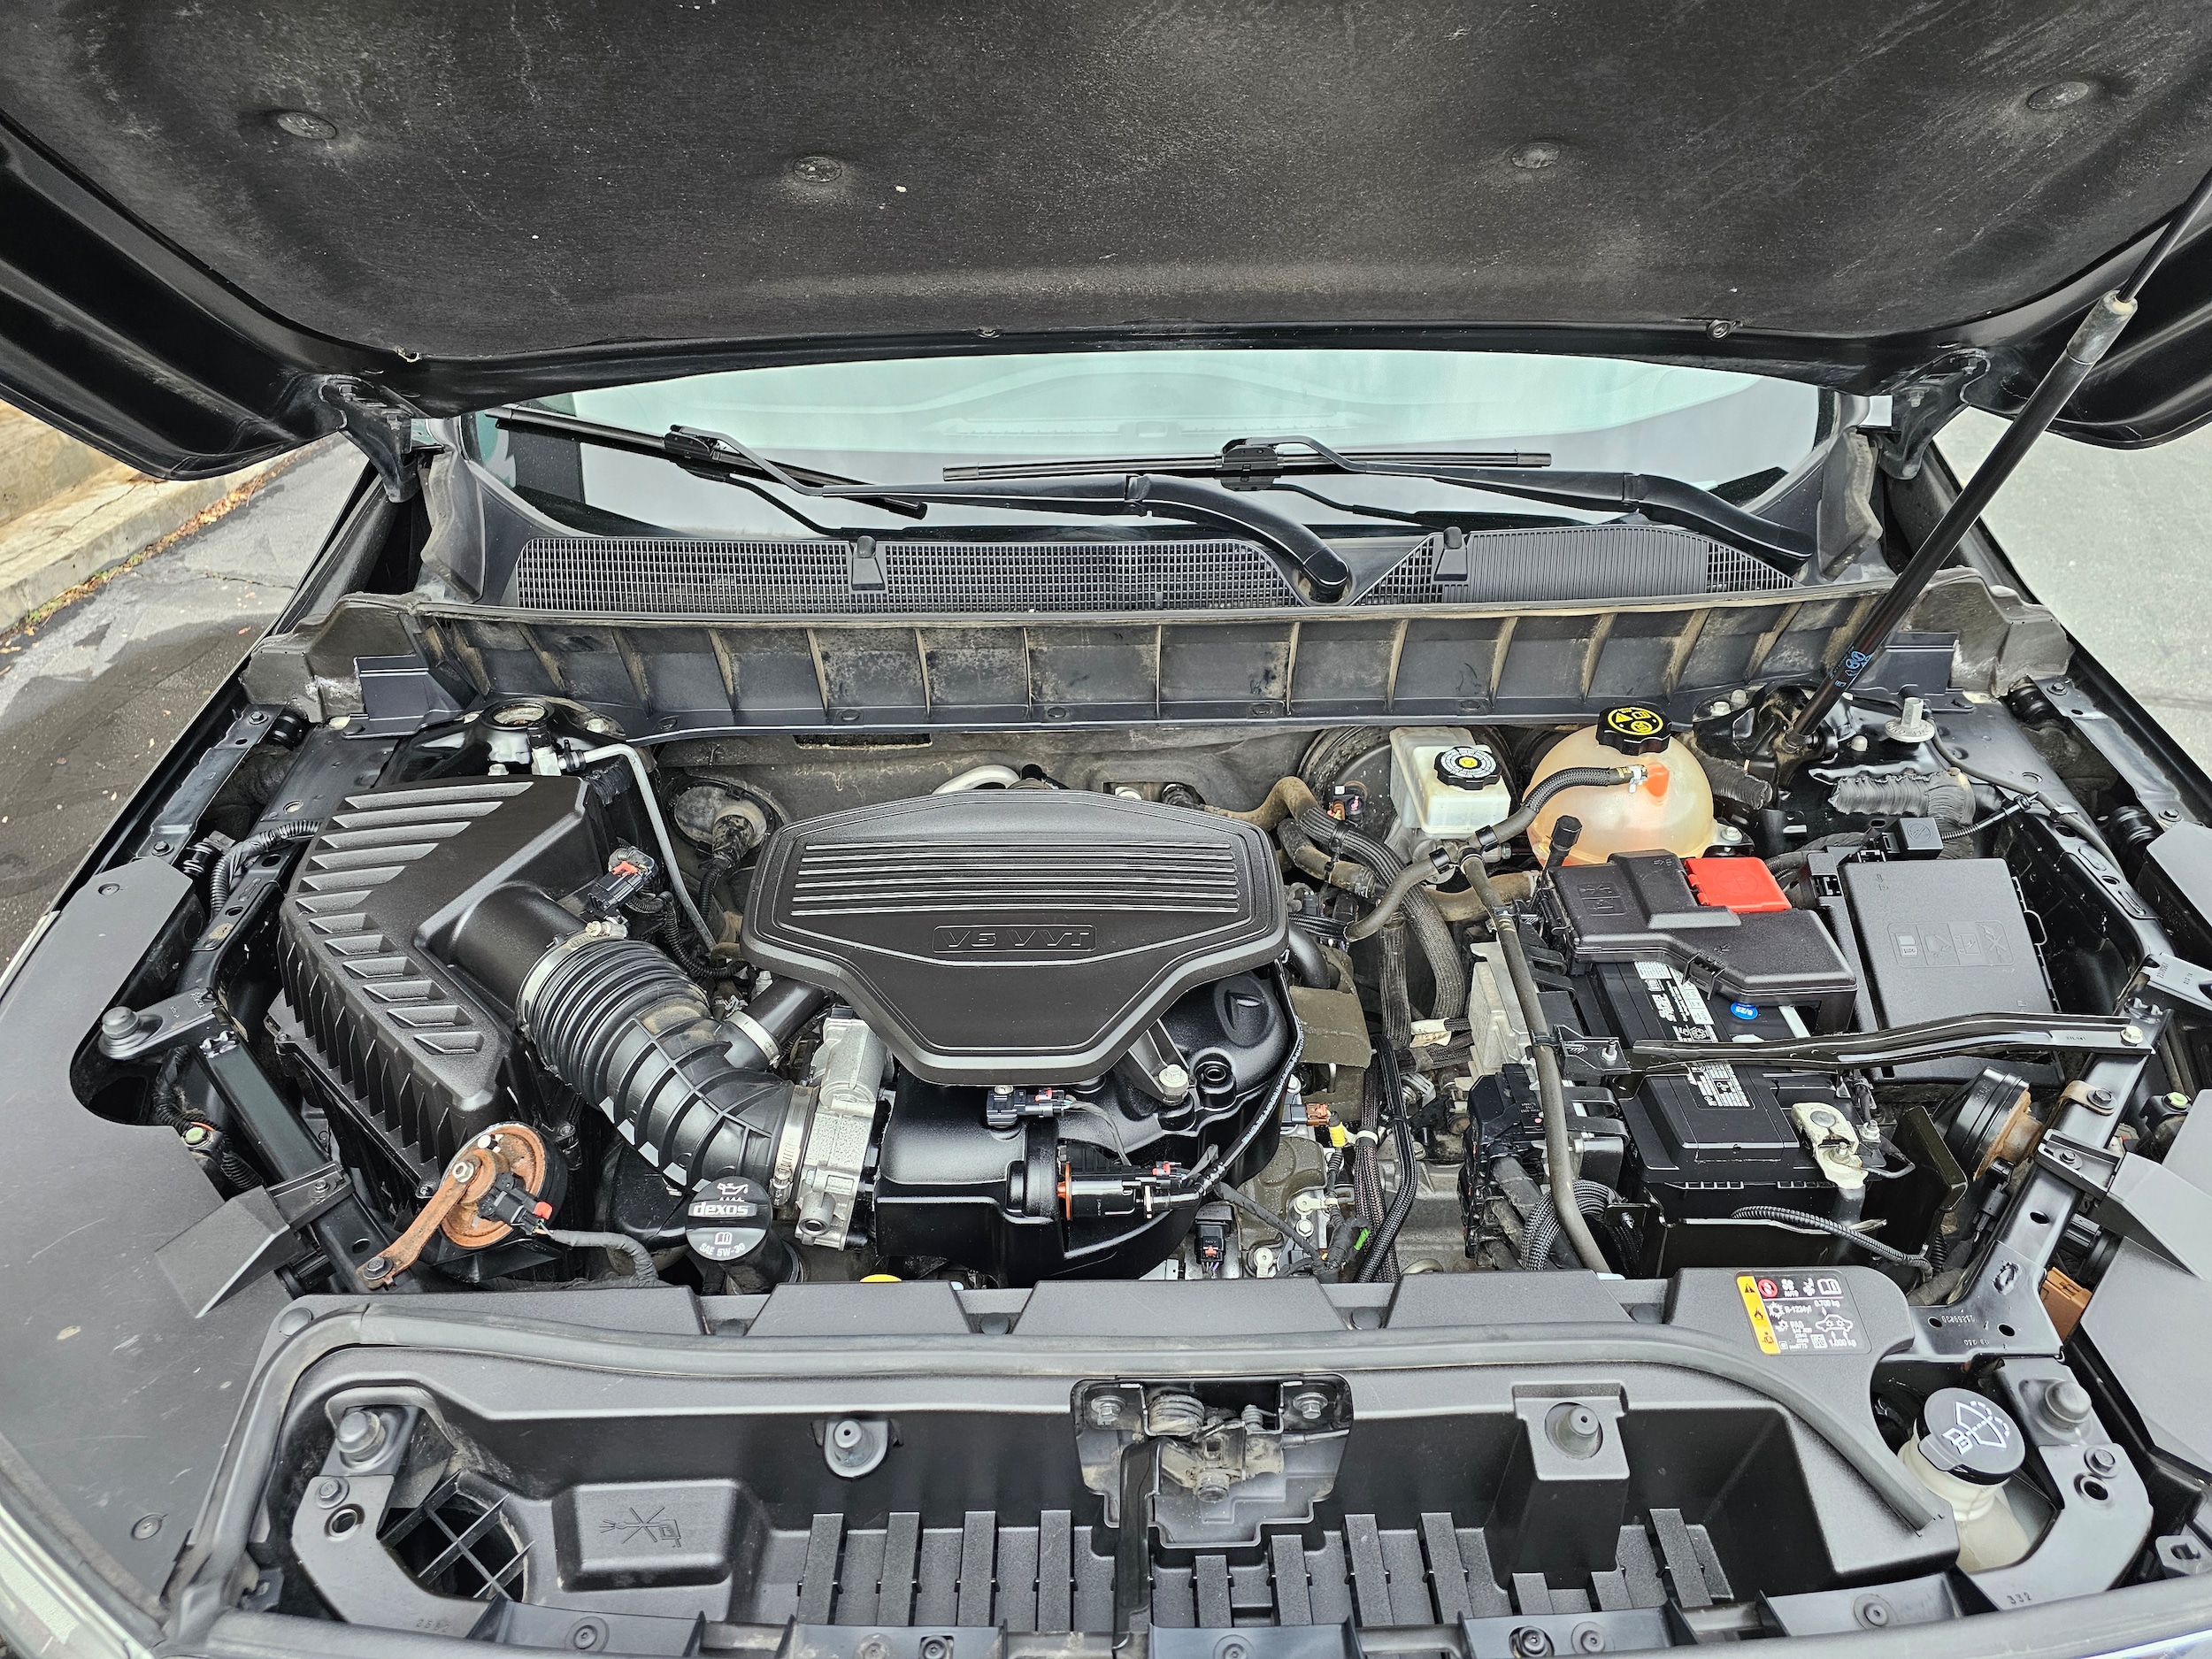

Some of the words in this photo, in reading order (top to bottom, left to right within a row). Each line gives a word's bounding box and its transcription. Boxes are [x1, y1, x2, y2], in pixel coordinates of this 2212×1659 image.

[940, 930, 996, 948] V6
[1006, 929, 1090, 947] VVT
[693, 1202, 749, 1216] dexos
[699, 1242, 715, 1256] SAE
[717, 1242, 746, 1256] 5W-30
